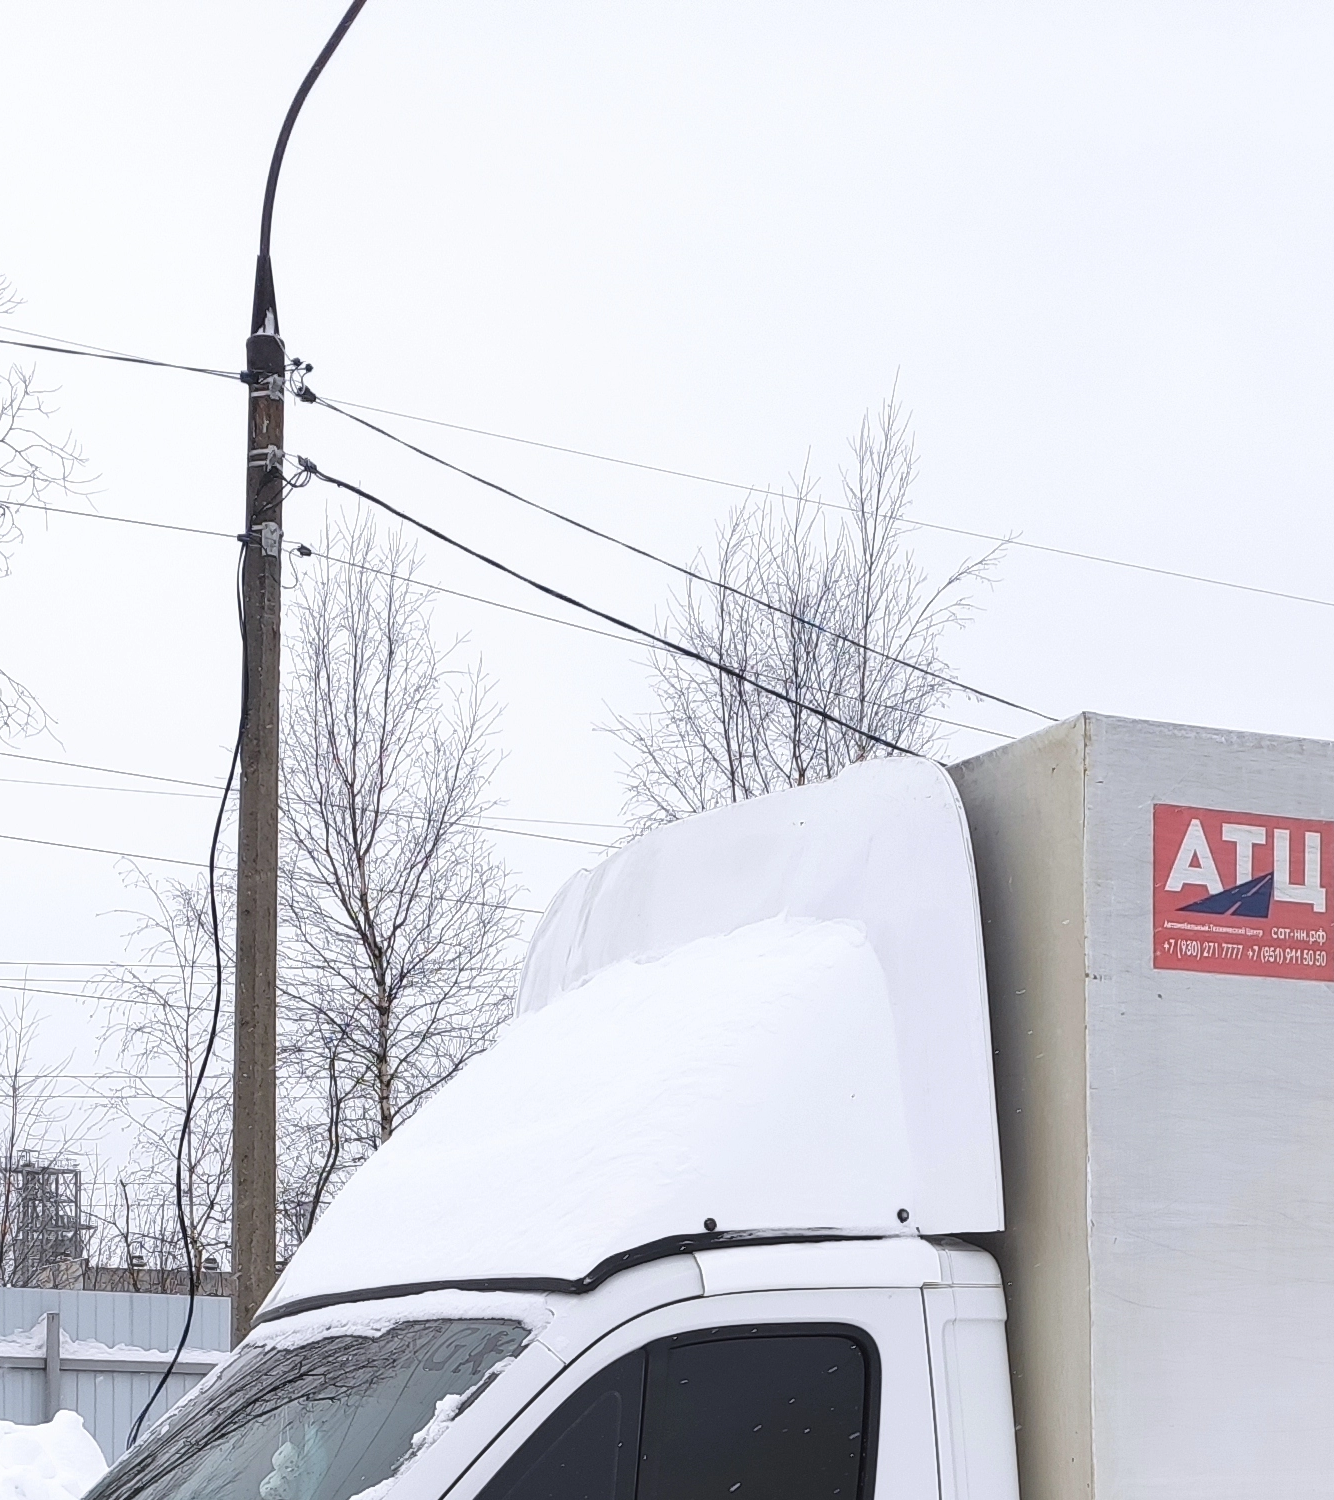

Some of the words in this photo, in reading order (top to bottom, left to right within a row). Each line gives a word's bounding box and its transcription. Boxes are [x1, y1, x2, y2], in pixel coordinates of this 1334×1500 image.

[1164, 818, 1327, 913] АТЦ
[1163, 939, 1175, 954] +7
[1177, 939, 1201, 961] (930)
[1203, 941, 1218, 958] 271
[1221, 942, 1244, 960] 7777
[1247, 945, 1259, 961] +7
[1285, 947, 1302, 965] 911
